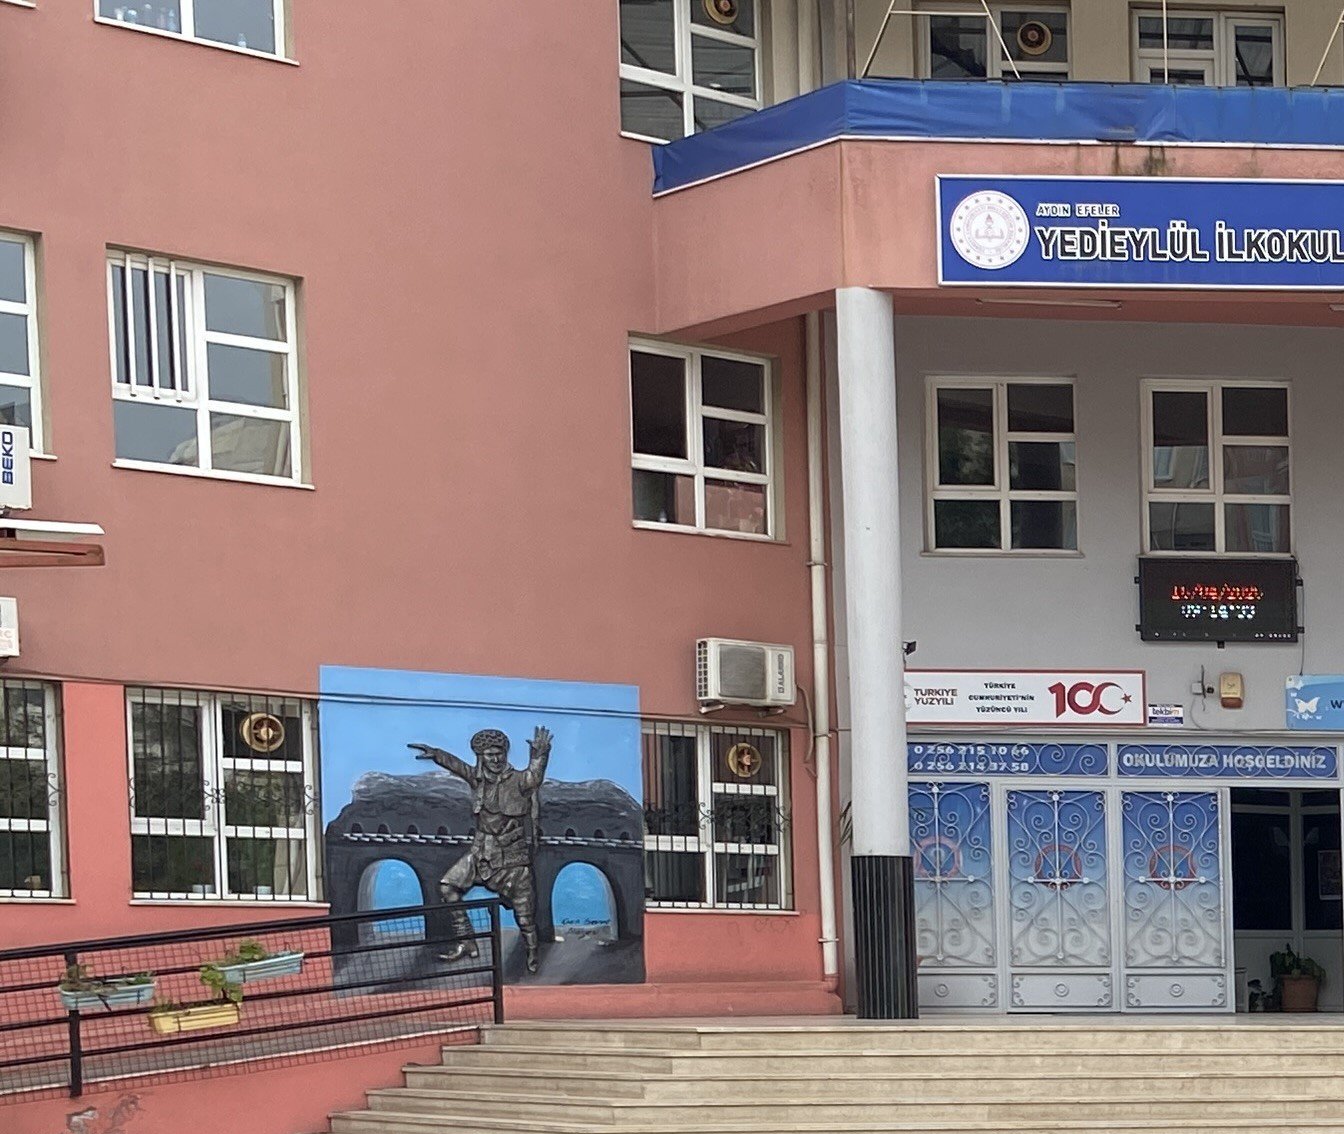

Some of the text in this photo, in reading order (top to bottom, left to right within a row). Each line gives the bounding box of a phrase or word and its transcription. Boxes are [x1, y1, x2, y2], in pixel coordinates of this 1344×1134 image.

[1036, 203, 1120, 217] AYDIN EFELER
[1034, 218, 1209, 262] YEDİEYLÜL
[2, 431, 14, 485] BEKO
[1048, 682, 1125, 718] 100
[1122, 752, 1327, 770] OKULUMUZA HOŞGELDİNİZ
